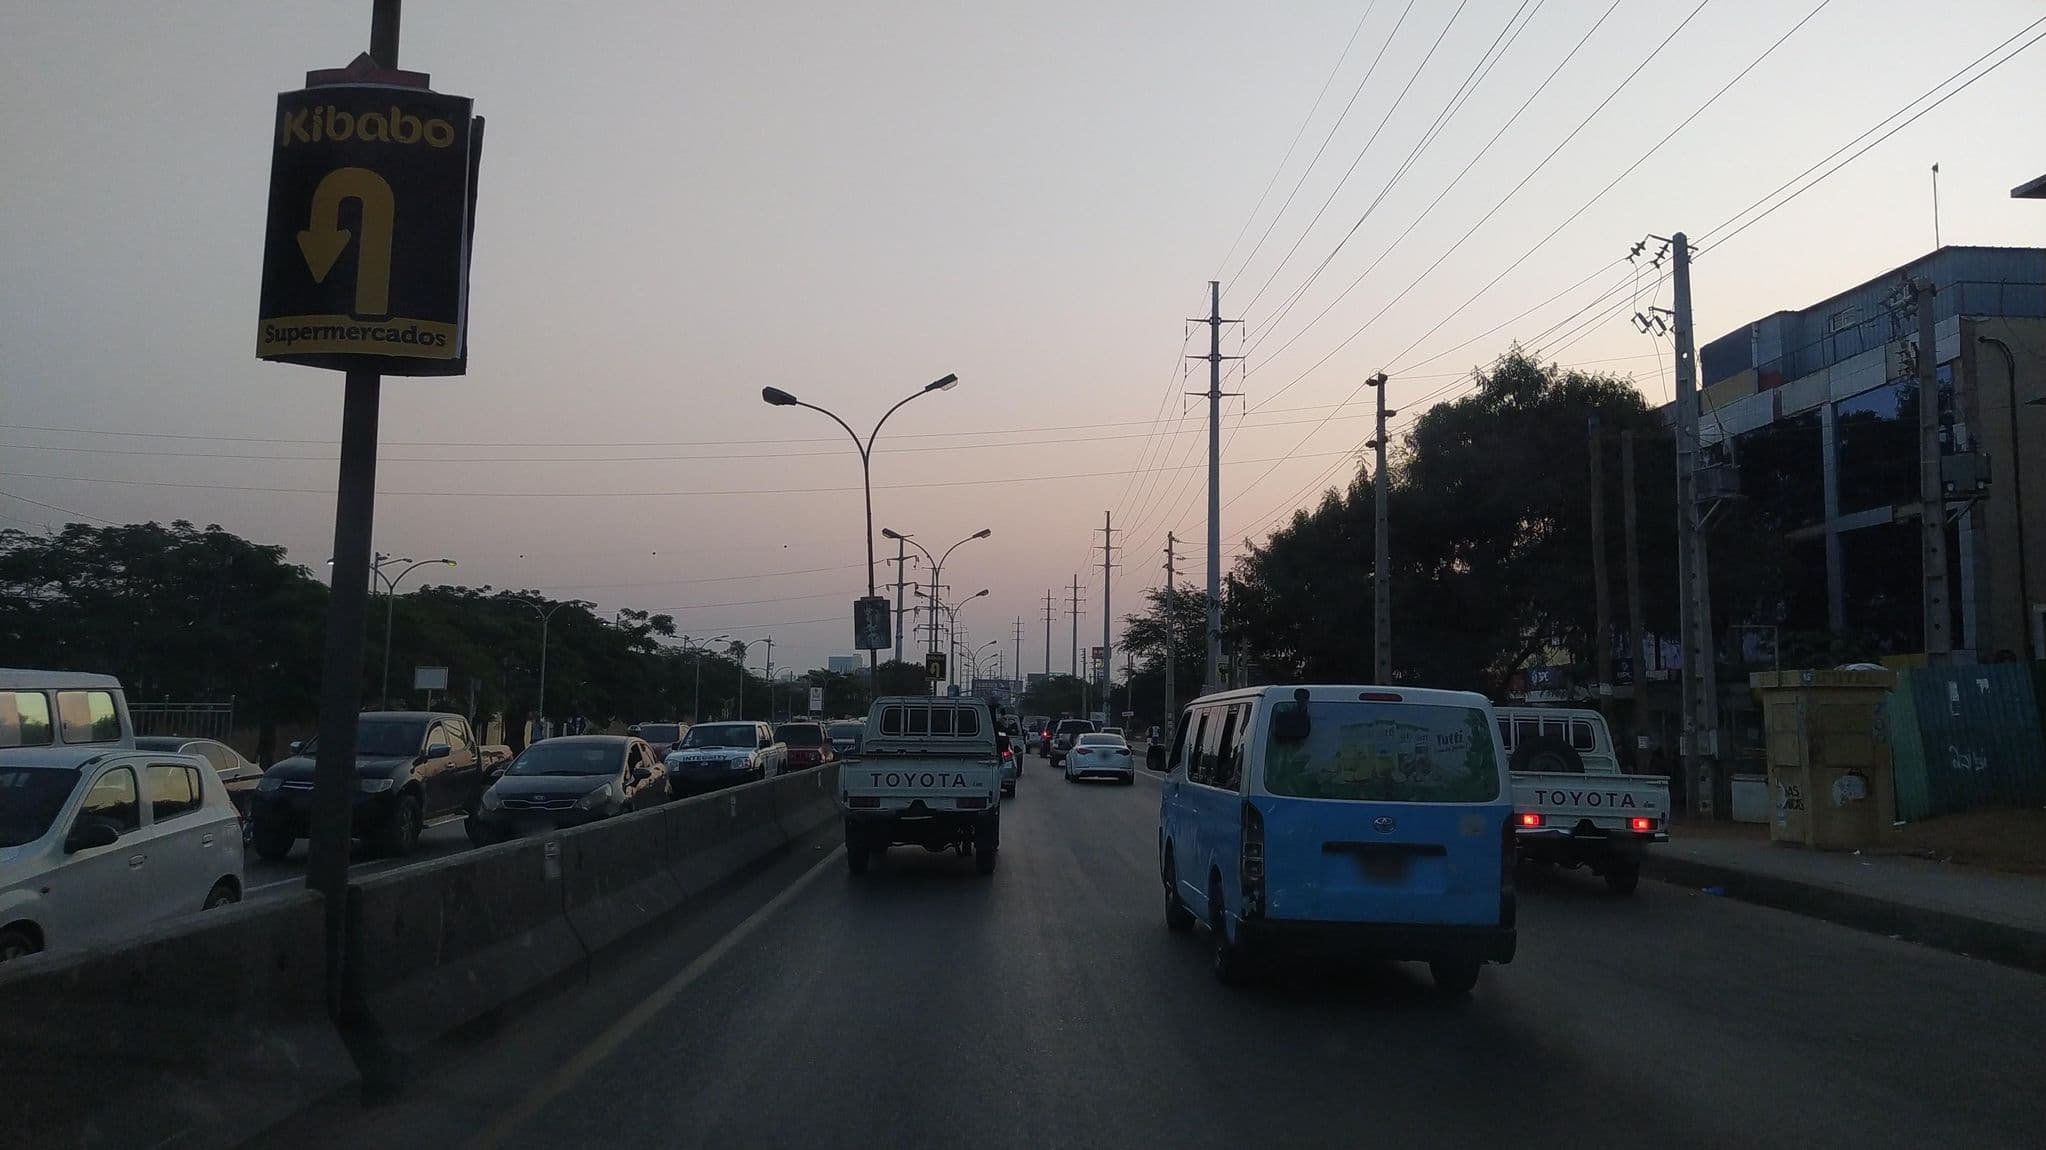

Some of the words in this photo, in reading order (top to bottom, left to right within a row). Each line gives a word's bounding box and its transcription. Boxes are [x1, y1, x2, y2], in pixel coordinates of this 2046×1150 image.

[281, 104, 455, 149] Kibabo
[264, 324, 448, 348] Supermercados
[870, 773, 967, 788] TOYOTA
[1535, 790, 1636, 808] TOYOTA
